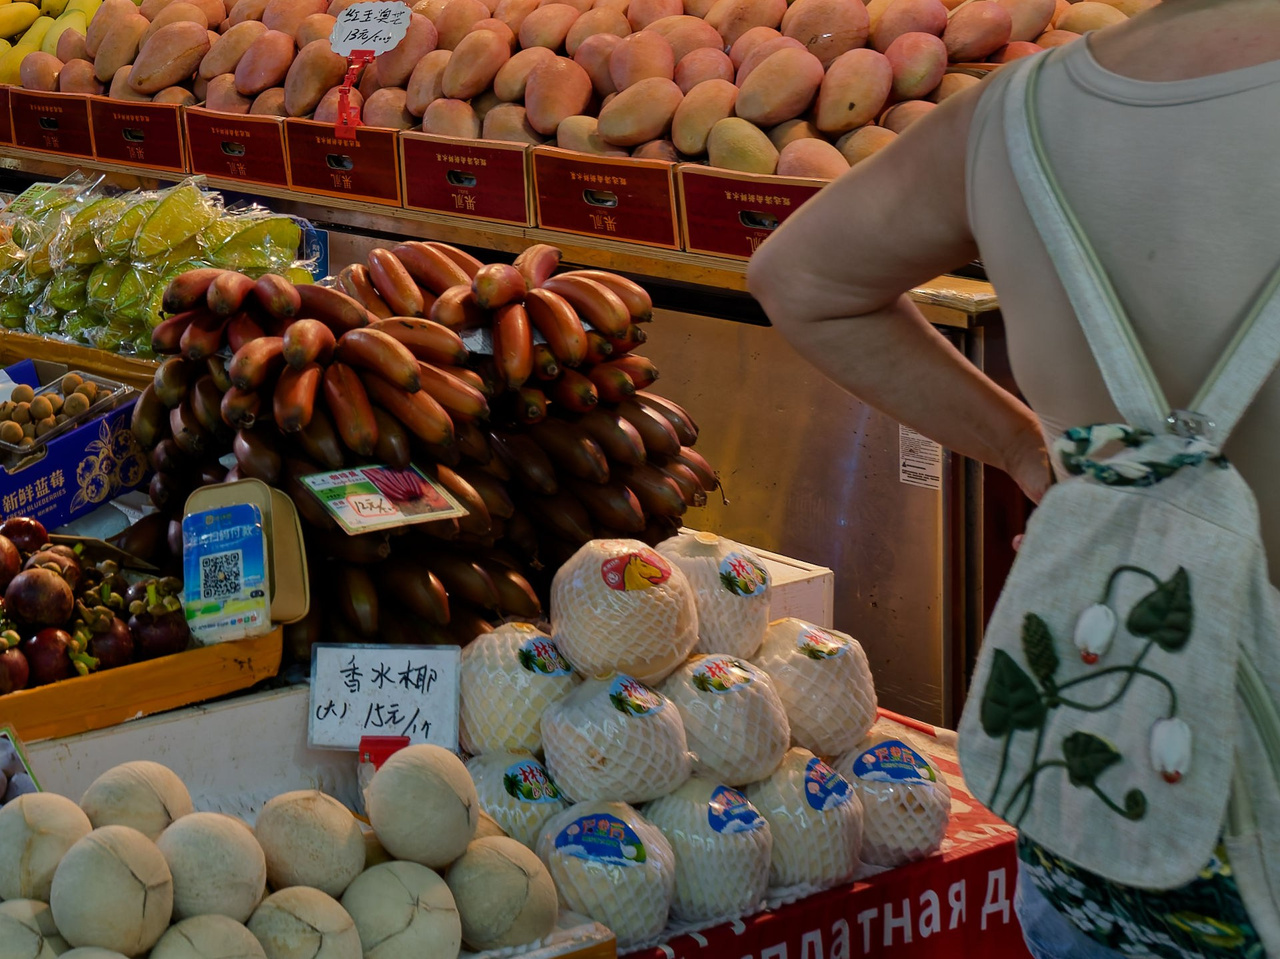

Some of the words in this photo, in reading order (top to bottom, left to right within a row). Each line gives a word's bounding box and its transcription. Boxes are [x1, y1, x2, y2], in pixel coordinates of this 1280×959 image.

[3, 469, 66, 513] 新鲜蓝莓
[340, 655, 437, 694] 香水椰
